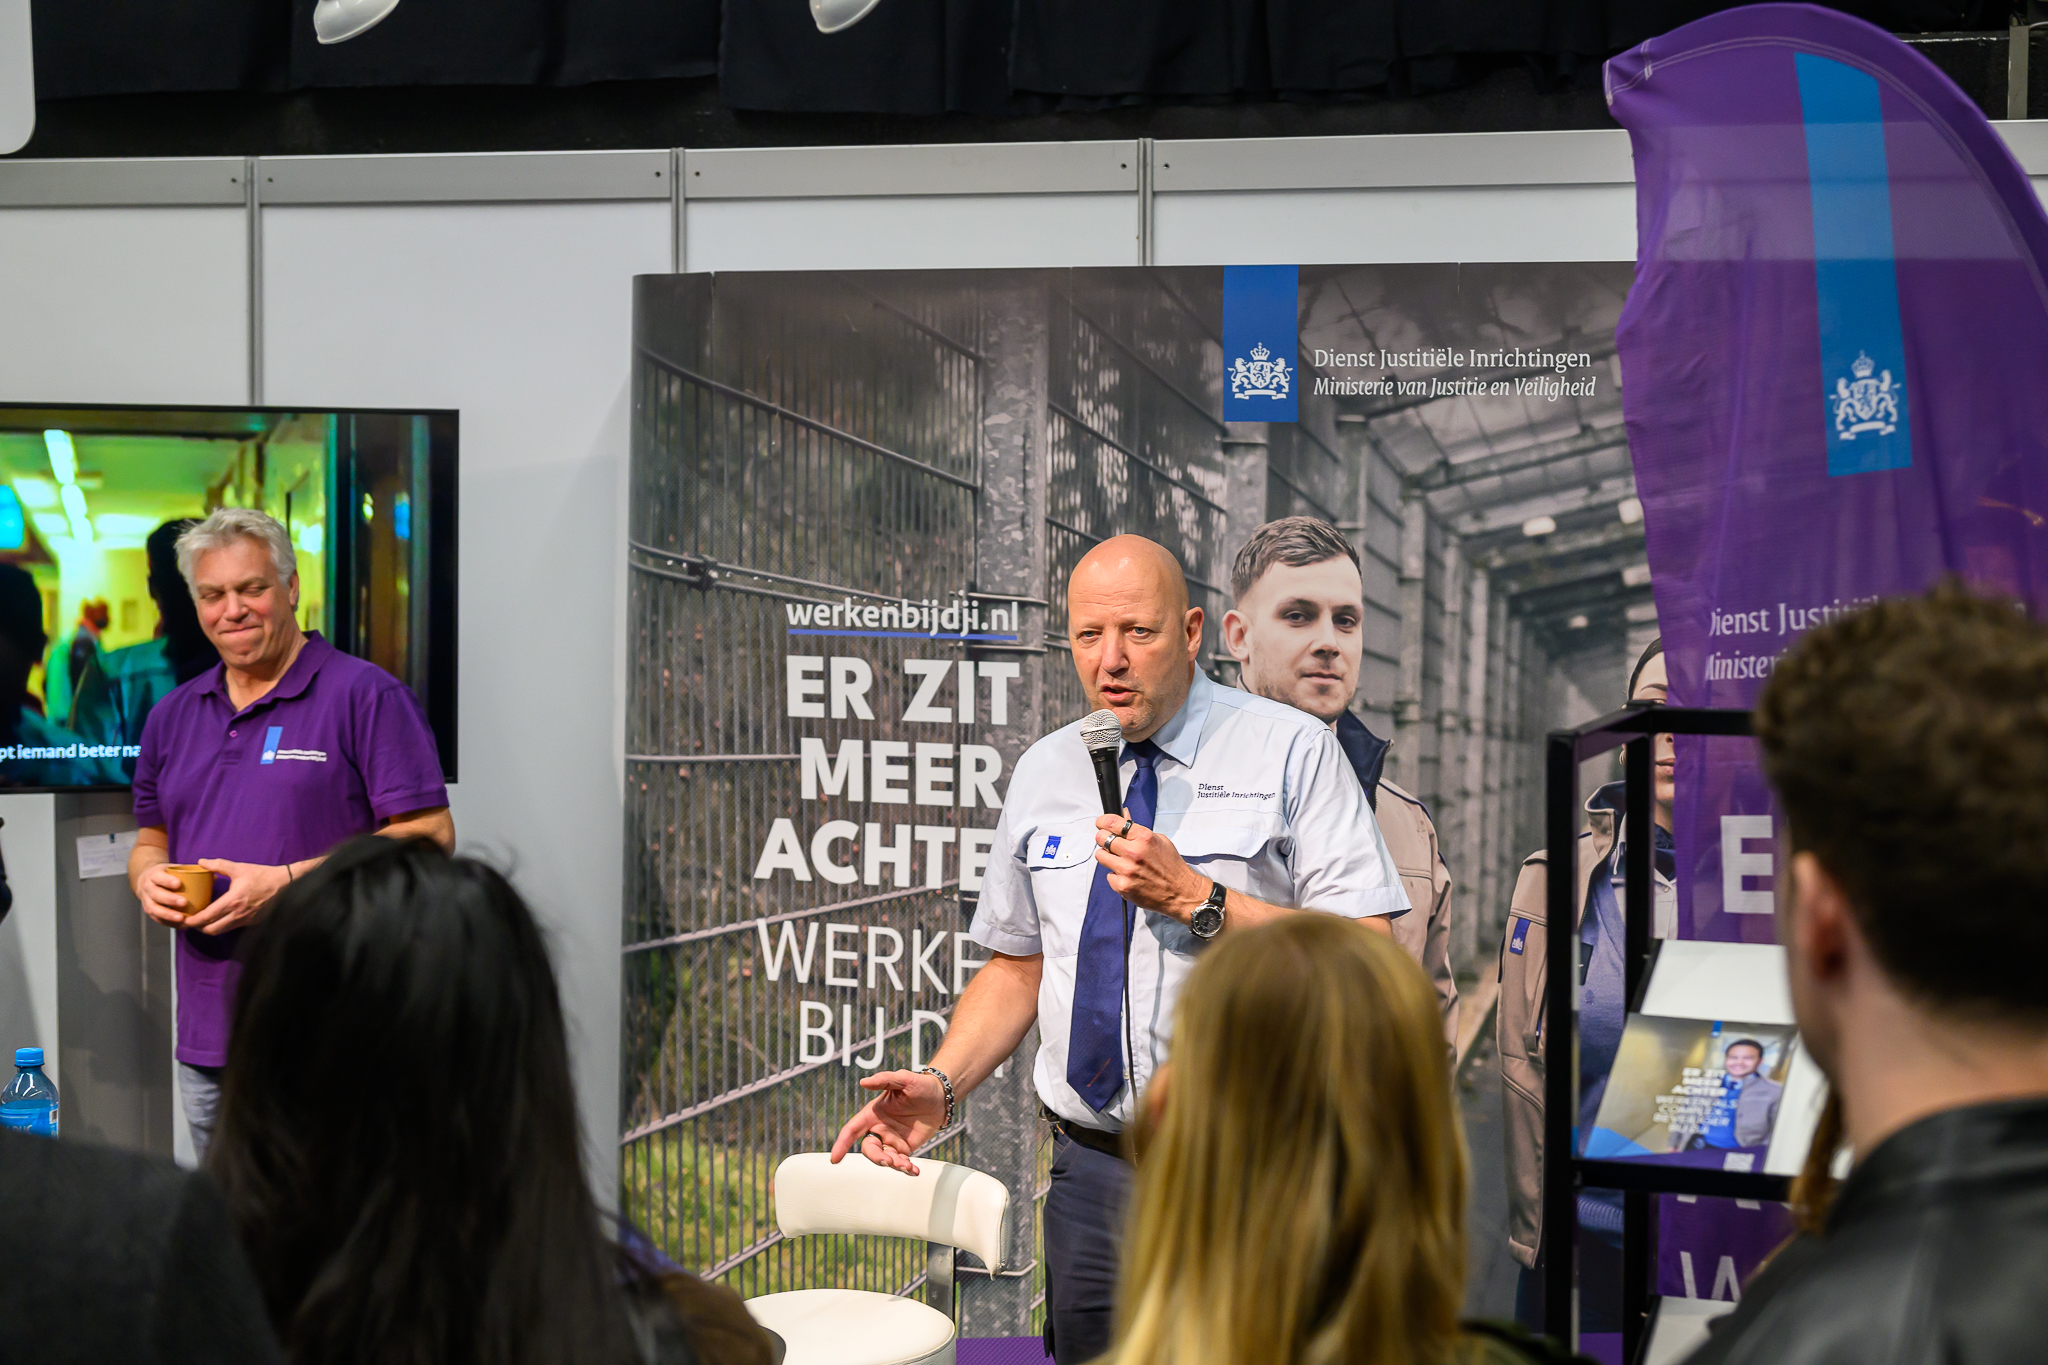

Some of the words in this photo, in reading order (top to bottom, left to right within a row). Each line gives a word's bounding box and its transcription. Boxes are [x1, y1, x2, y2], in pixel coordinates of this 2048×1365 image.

[1314, 348, 1376, 367] Dienst
[1380, 346, 1465, 370] Justitiële
[1469, 347, 1592, 373] Inrichtingen
[1313, 376, 1394, 395] Ministerie
[1397, 381, 1427, 395] van
[1429, 376, 1488, 398] Justitie
[1490, 381, 1510, 396] en
[1514, 376, 1597, 402] Veiligheid
[786, 597, 1018, 638] werkenbijdji.nl
[786, 654, 875, 720] ER
[902, 658, 1020, 725] ZIT
[17, 743, 77, 760] iemand
[78, 743, 122, 758] beter
[801, 737, 1003, 809] MEER
[1198, 783, 1224, 791] Dienst
[1231, 791, 1276, 801] Inrichtingen
[753, 817, 997, 892] ACHTE
[1721, 815, 1775, 915] E
[756, 918, 989, 995] WERKE
[799, 1000, 885, 1070] BIJ
